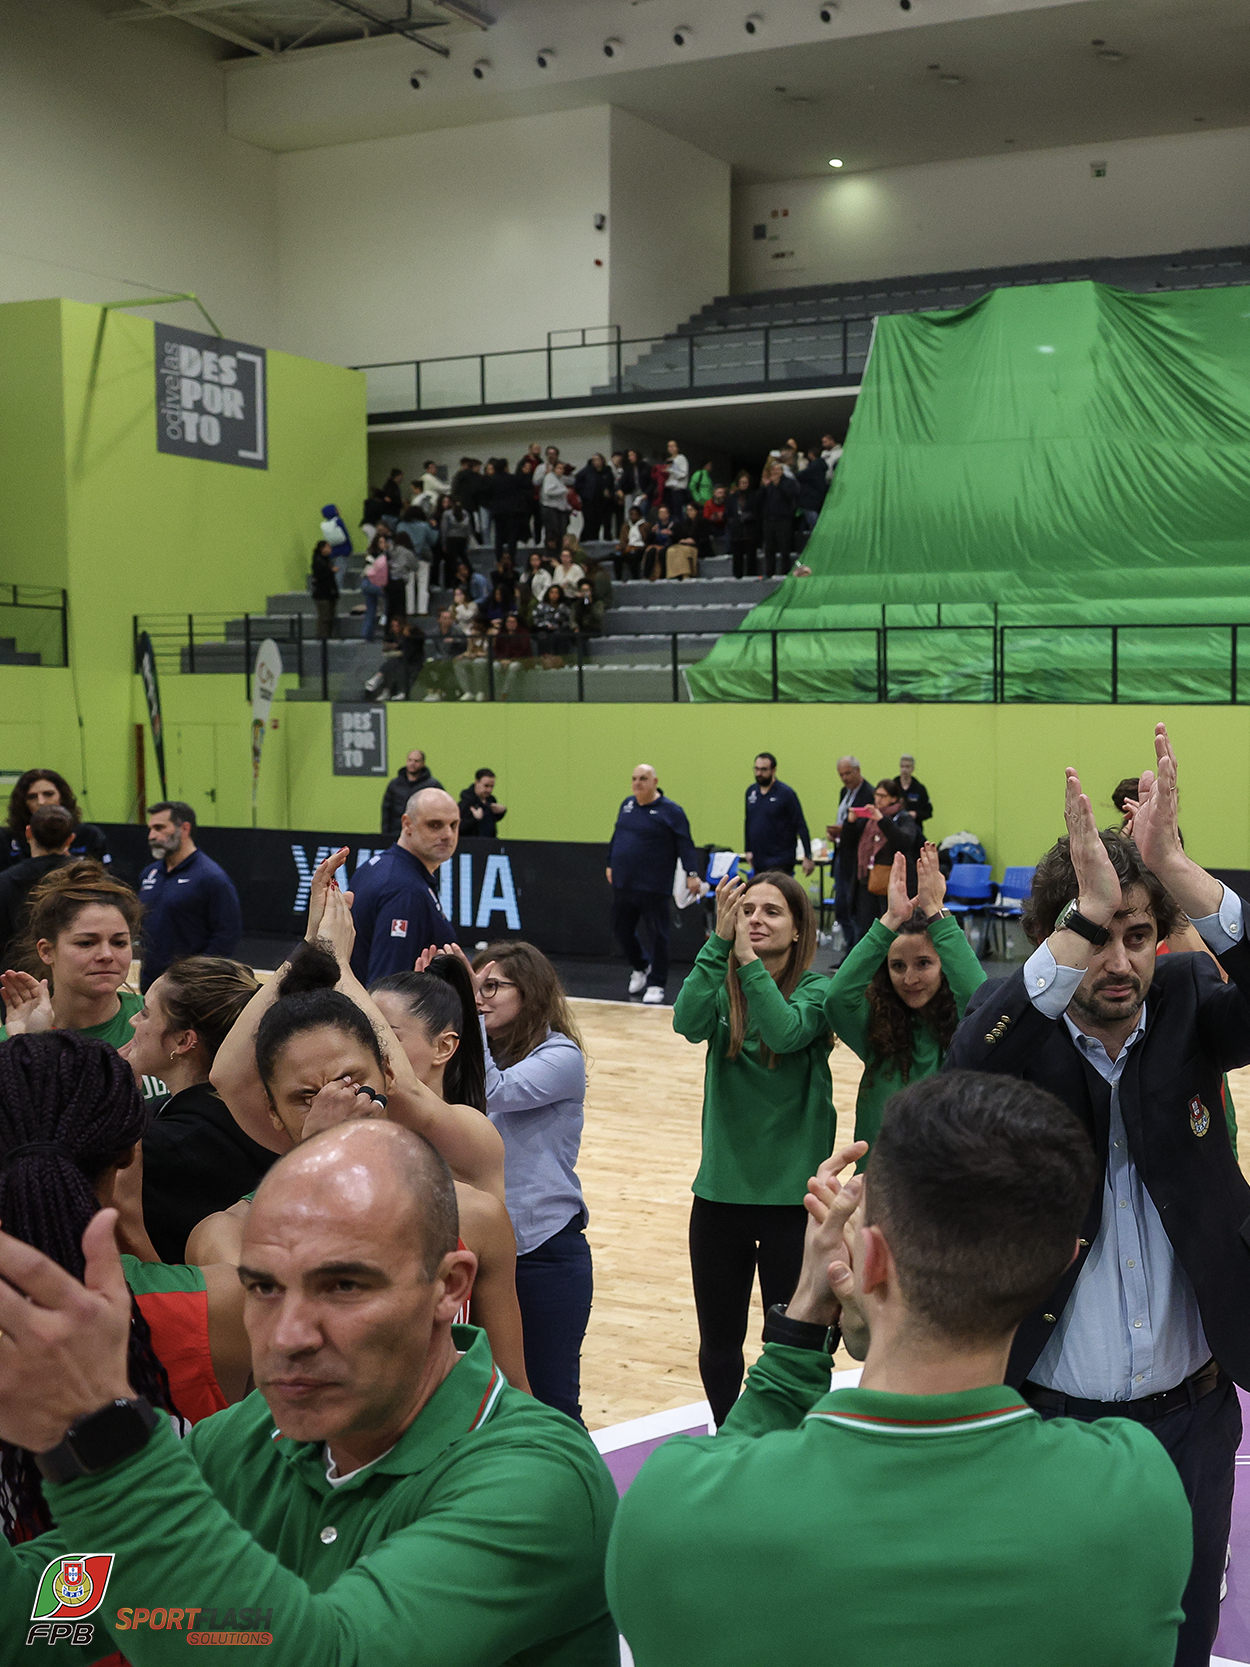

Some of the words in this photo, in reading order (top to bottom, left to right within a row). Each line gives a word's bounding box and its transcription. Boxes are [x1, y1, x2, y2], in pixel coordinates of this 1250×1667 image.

[179, 344, 238, 386] DES
[160, 341, 183, 441] odivelas
[180, 377, 245, 421] POR
[180, 410, 221, 446] TO
[342, 711, 371, 730] DES
[343, 750, 363, 768] TO
